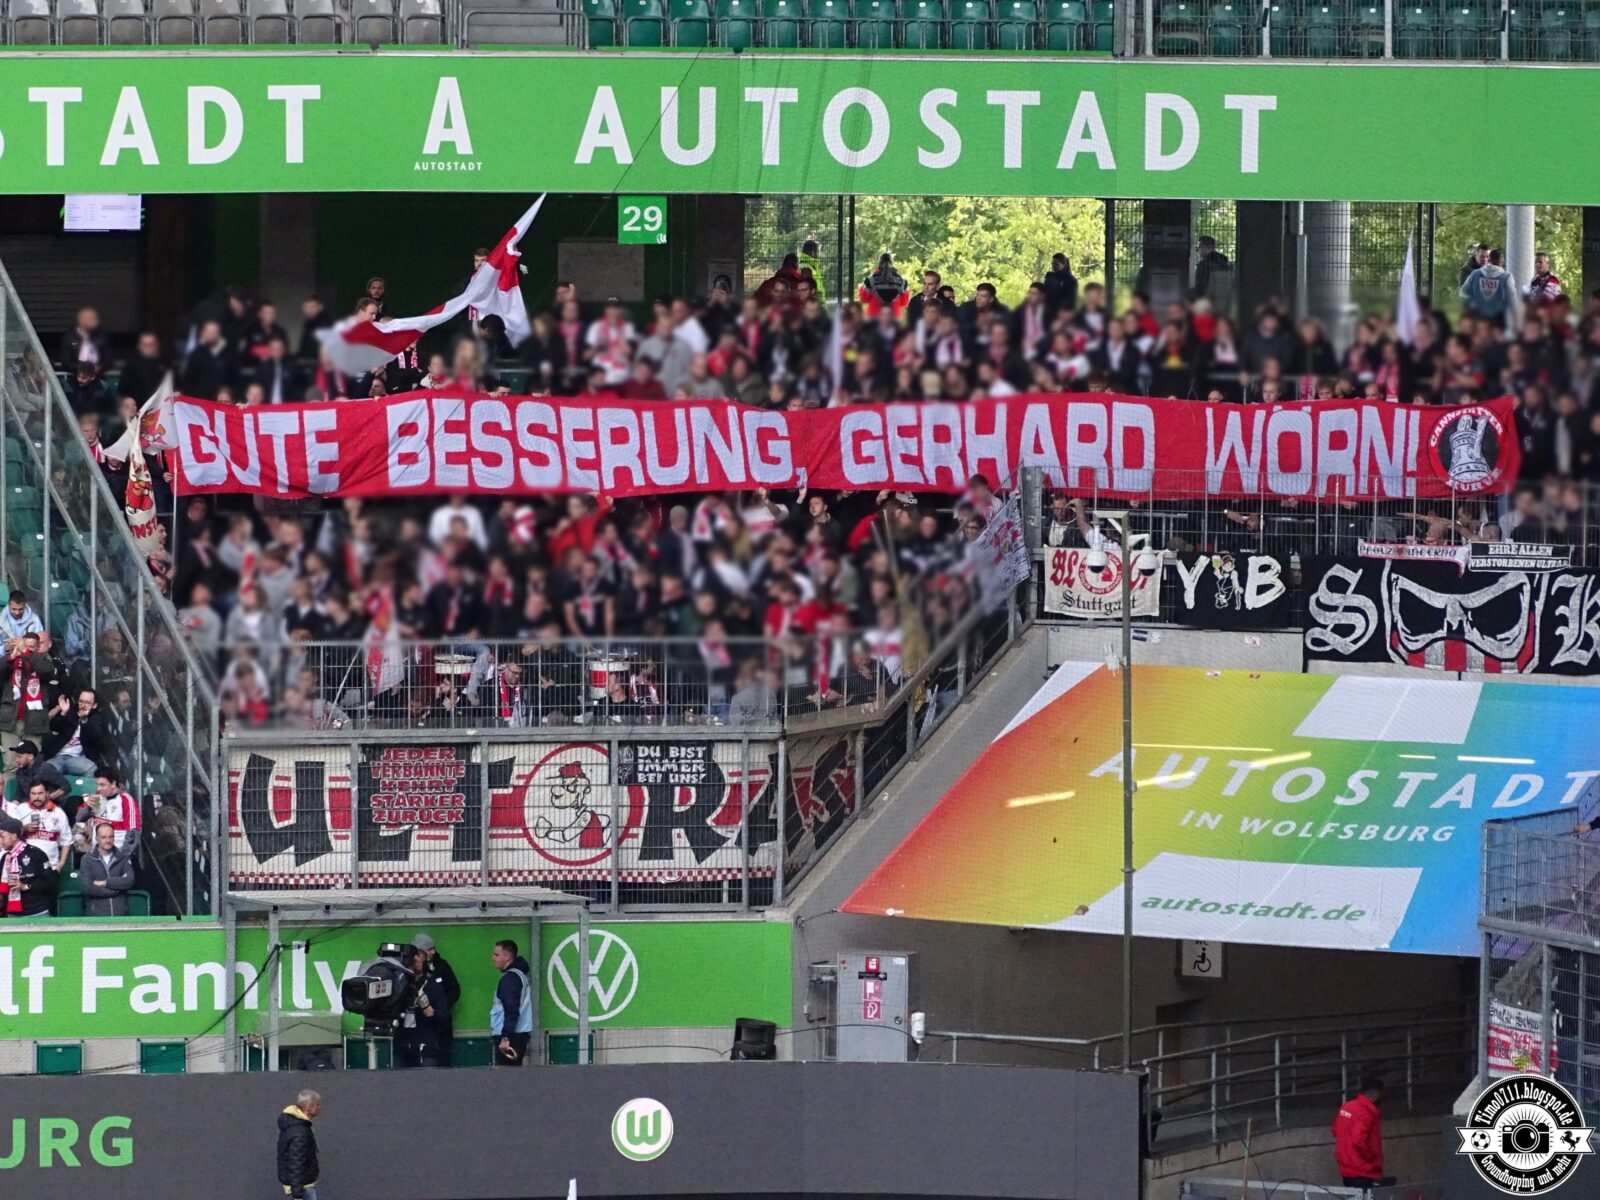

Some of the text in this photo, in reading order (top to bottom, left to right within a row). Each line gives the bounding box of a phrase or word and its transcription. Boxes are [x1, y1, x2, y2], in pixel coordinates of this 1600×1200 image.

[0, 83, 321, 166] TADT
[574, 84, 1278, 174] AUTOSTADT
[414, 161, 483, 171] AUTOSTADT
[623, 205, 662, 232] 29
[173, 400, 340, 495] GUTE
[839, 400, 1156, 493] GERHARD
[1204, 404, 1421, 498] WÖRN!
[1488, 544, 1554, 556] EHRE ALLEN
[1059, 590, 1137, 616] Stuttgat
[380, 747, 456, 761] JEDER
[637, 745, 707, 758] DU BIST
[637, 759, 706, 773] IMMER
[637, 772, 663, 784] BEI
[1088, 746, 1600, 811] AUTOSTADT
[1179, 809, 1458, 843] IN WOLFSBURG
[1140, 893, 1368, 923] autostadt.de
[81, 941, 362, 1017] Famly
